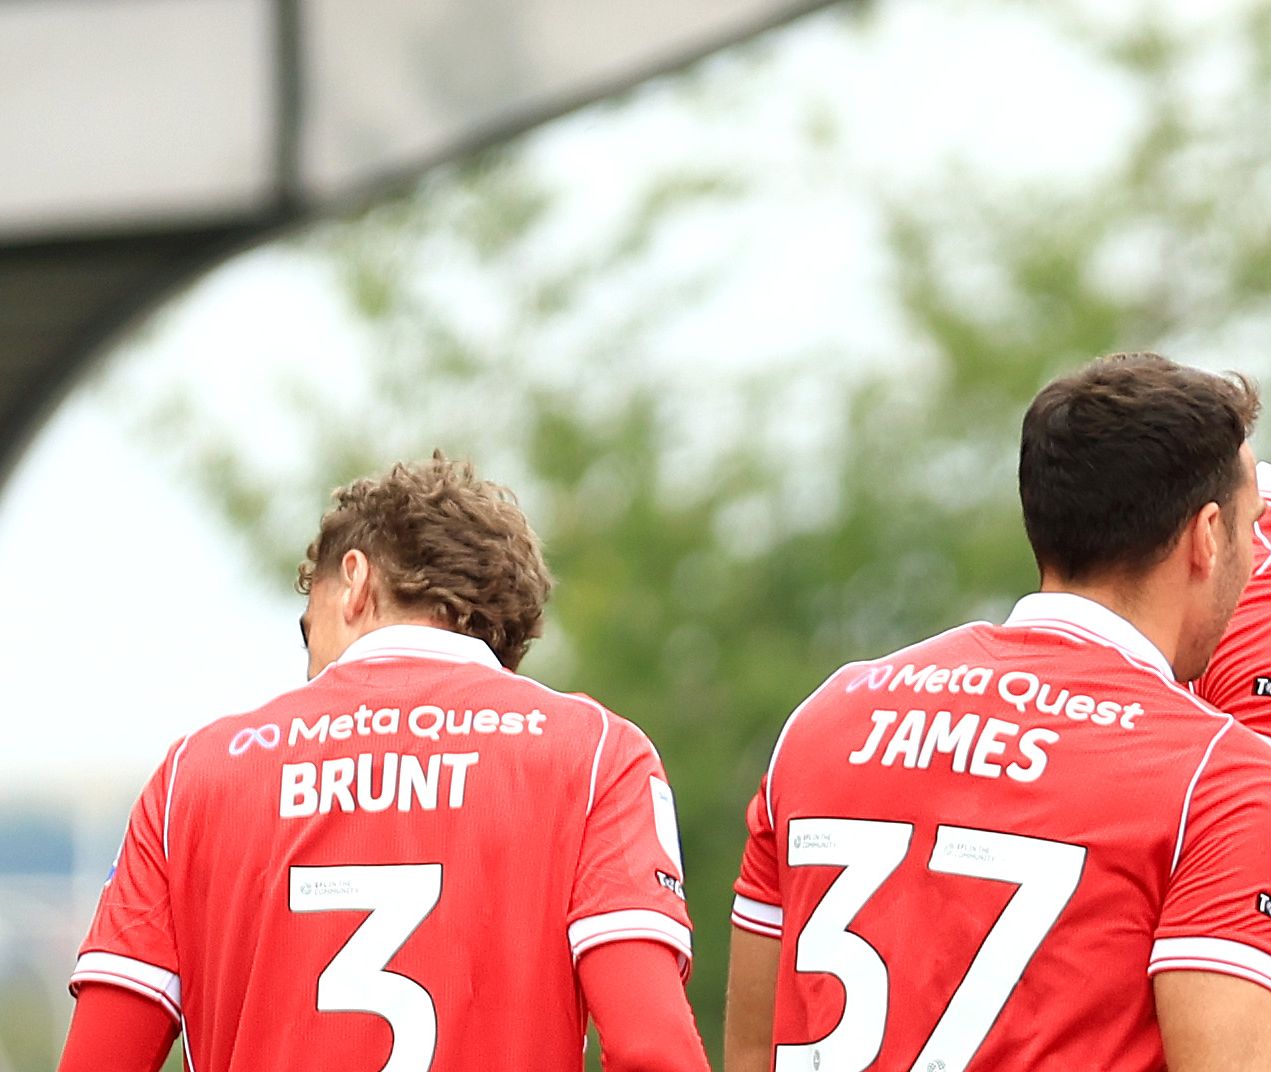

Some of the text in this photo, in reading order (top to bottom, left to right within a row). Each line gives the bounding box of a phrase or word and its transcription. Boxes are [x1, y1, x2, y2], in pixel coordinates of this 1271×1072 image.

[287, 703, 547, 747] Meta Quest
[887, 664, 1145, 730] Meta Quest
[848, 708, 1061, 783] JAMES
[279, 751, 480, 820] BRUNT
